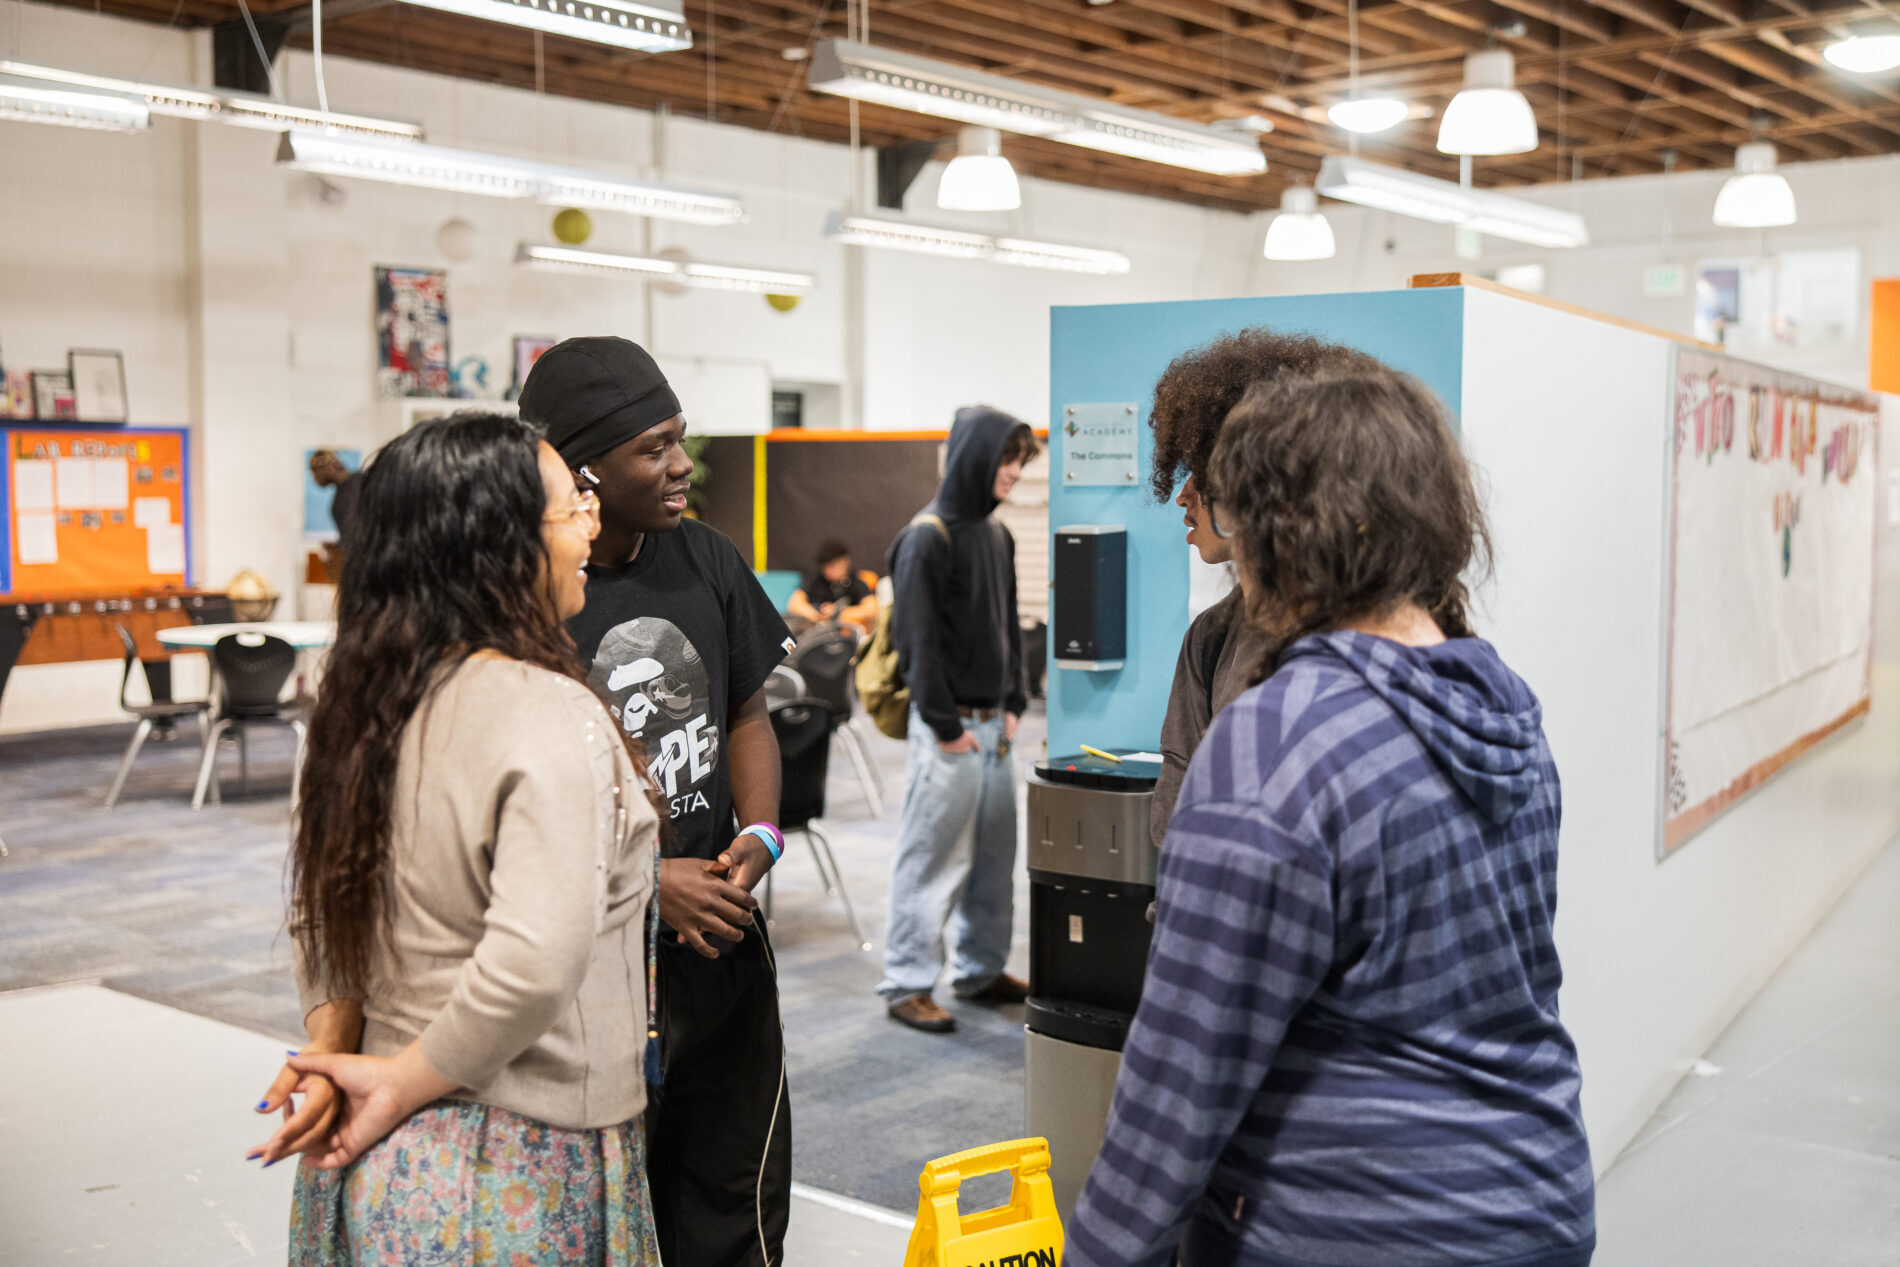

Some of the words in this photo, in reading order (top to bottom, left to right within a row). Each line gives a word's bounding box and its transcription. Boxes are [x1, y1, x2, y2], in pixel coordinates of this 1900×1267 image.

[1083, 427, 1132, 436] ACADEMY
[1071, 451, 1086, 460] The
[1088, 451, 1133, 460] Commons
[670, 791, 710, 819] STA
[965, 1246, 1056, 1267] TION
